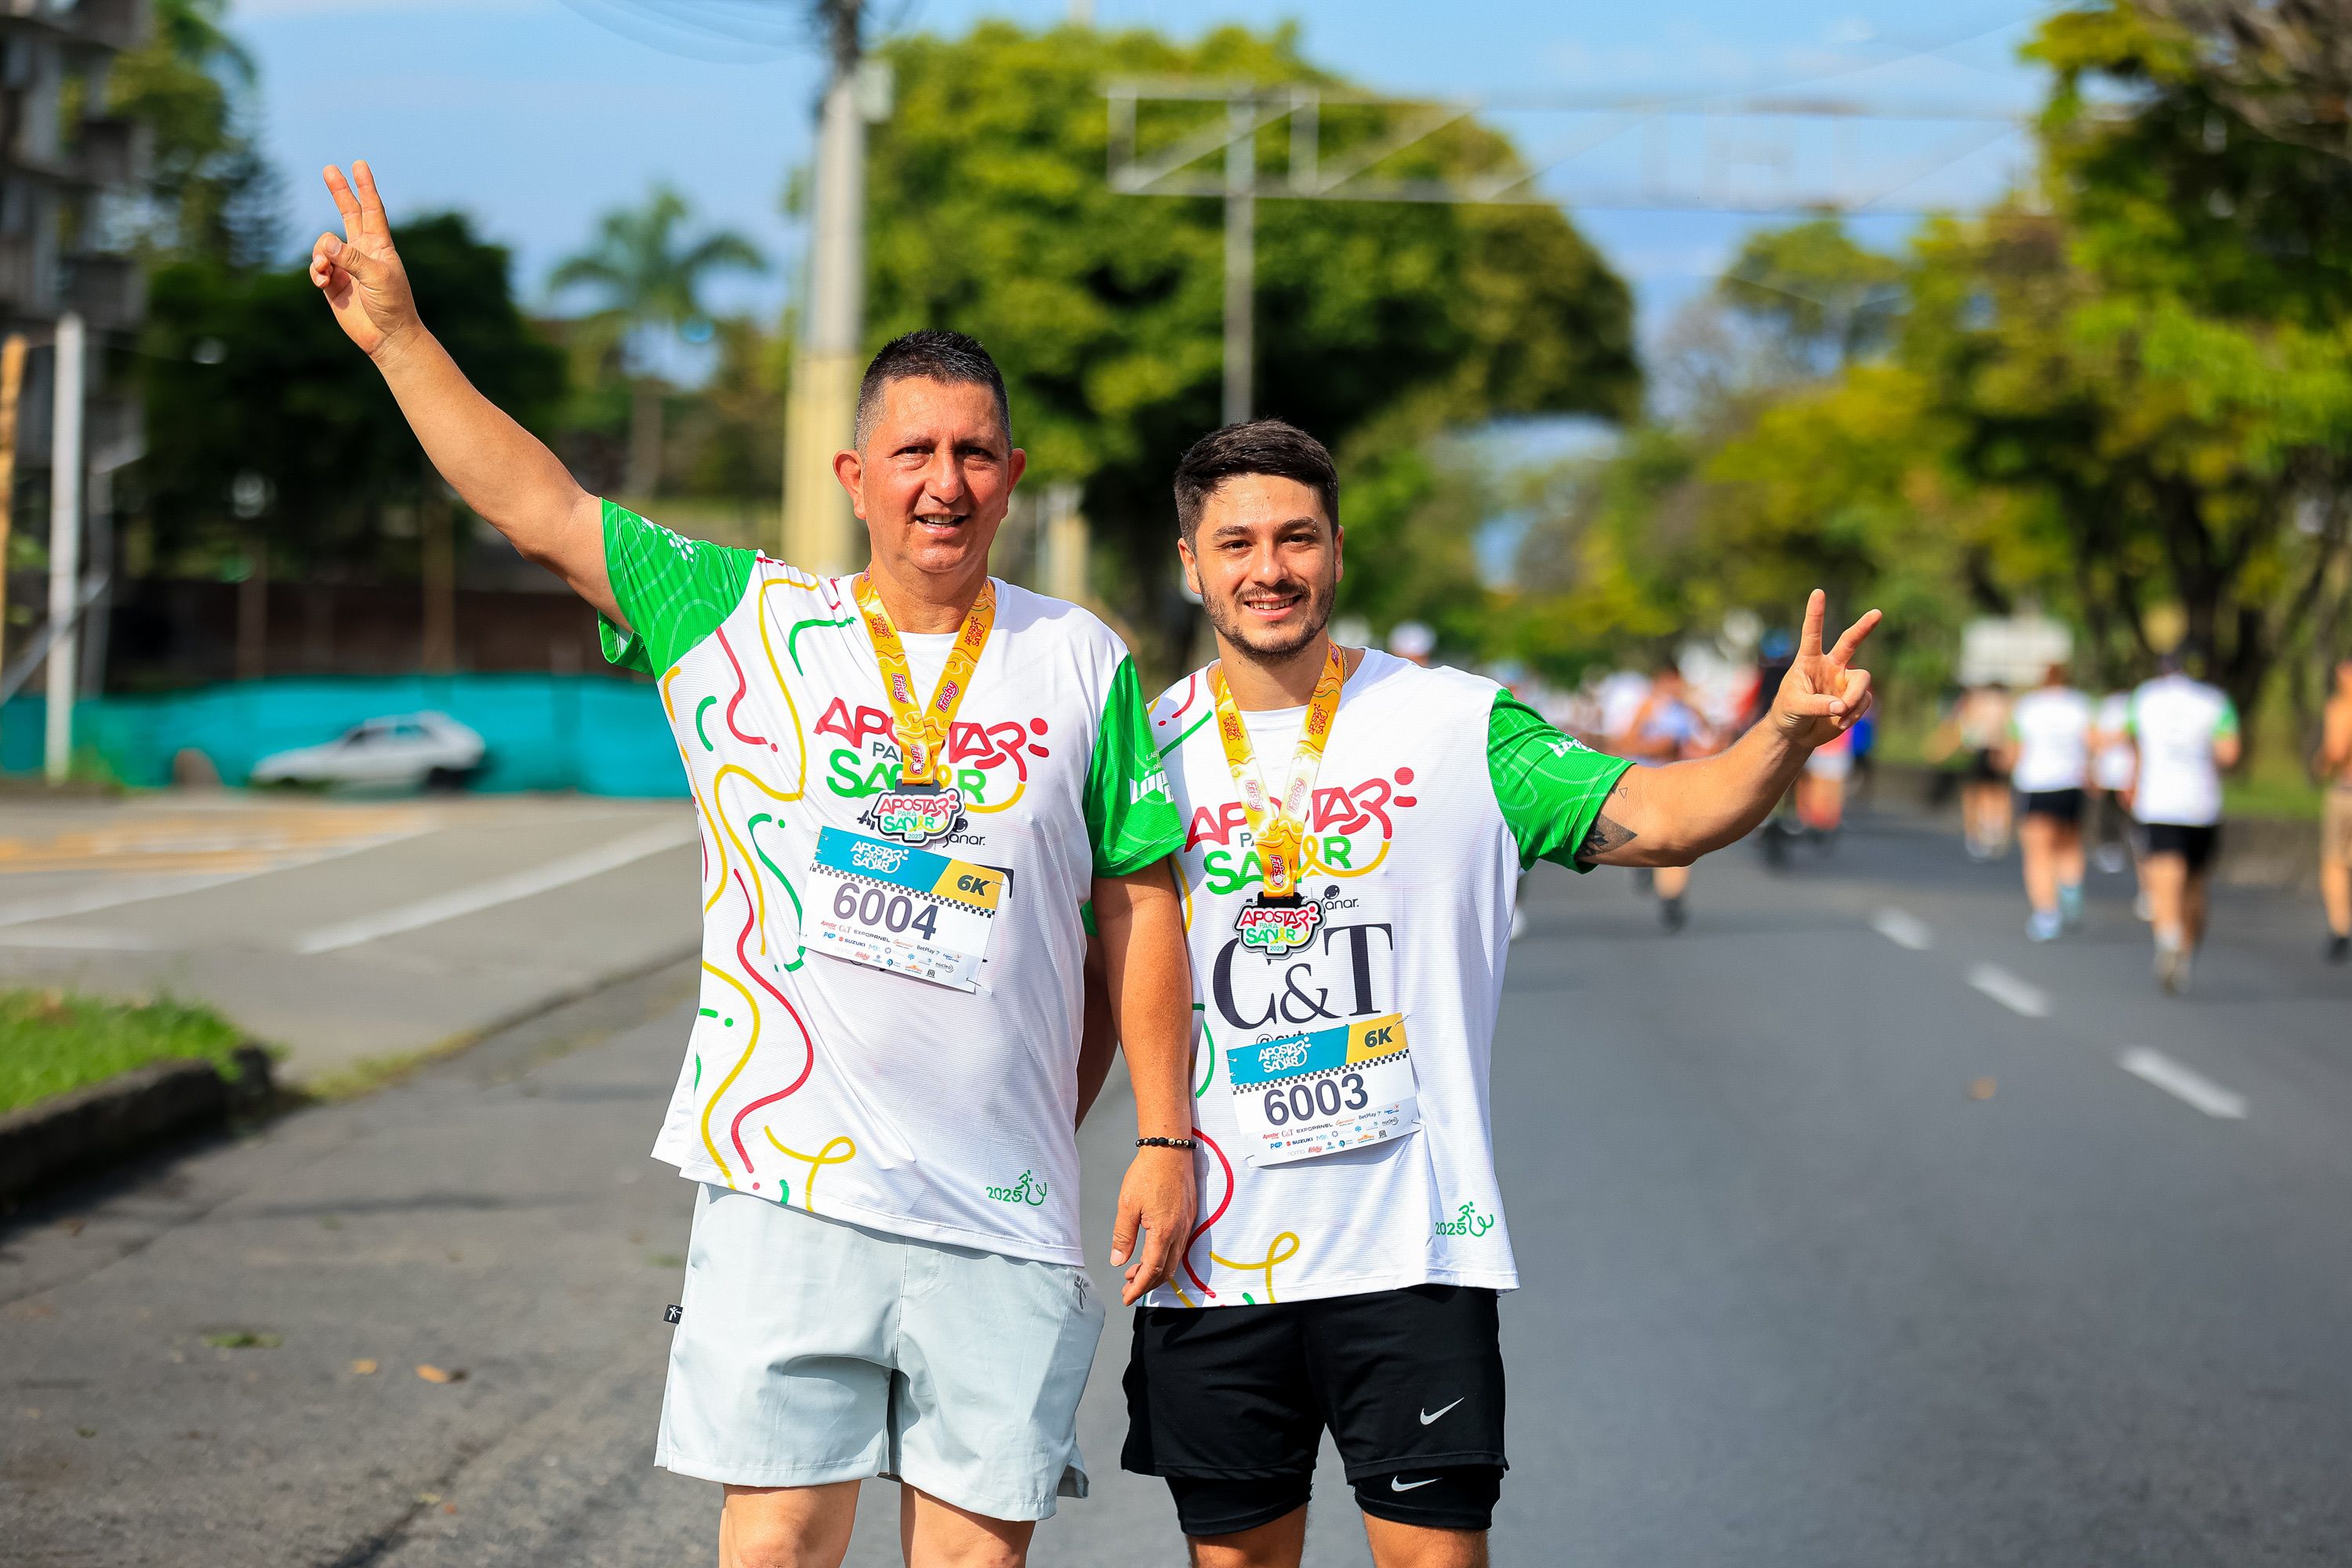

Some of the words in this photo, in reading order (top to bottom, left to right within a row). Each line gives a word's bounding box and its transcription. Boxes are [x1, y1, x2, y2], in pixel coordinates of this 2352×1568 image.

[891, 673, 909, 704] Frisby
[935, 680, 959, 713] Frisby
[813, 696, 1029, 782] APTAR
[1244, 779, 1265, 812] Frisby
[1287, 777, 1308, 814] Frisby
[878, 797, 950, 820] APOSTAR
[1184, 777, 1393, 854] APTAR
[850, 840, 904, 863] APOSTAR
[956, 875, 991, 897] 6K
[833, 883, 939, 941] 6004
[1240, 909, 1309, 931] APOSTAR
[844, 938, 866, 947] SUZUKI
[854, 929, 891, 943] EXPOPANEL
[1212, 923, 1394, 1030] C&T
[1364, 1025, 1393, 1048] 6K
[1258, 1040, 1307, 1062] APOSTAR
[1264, 1073, 1369, 1127] 6003
[1296, 1123, 1333, 1134] EXPOPANEL
[985, 1186, 1023, 1203] 2025
[1435, 1221, 1467, 1236] 2025
